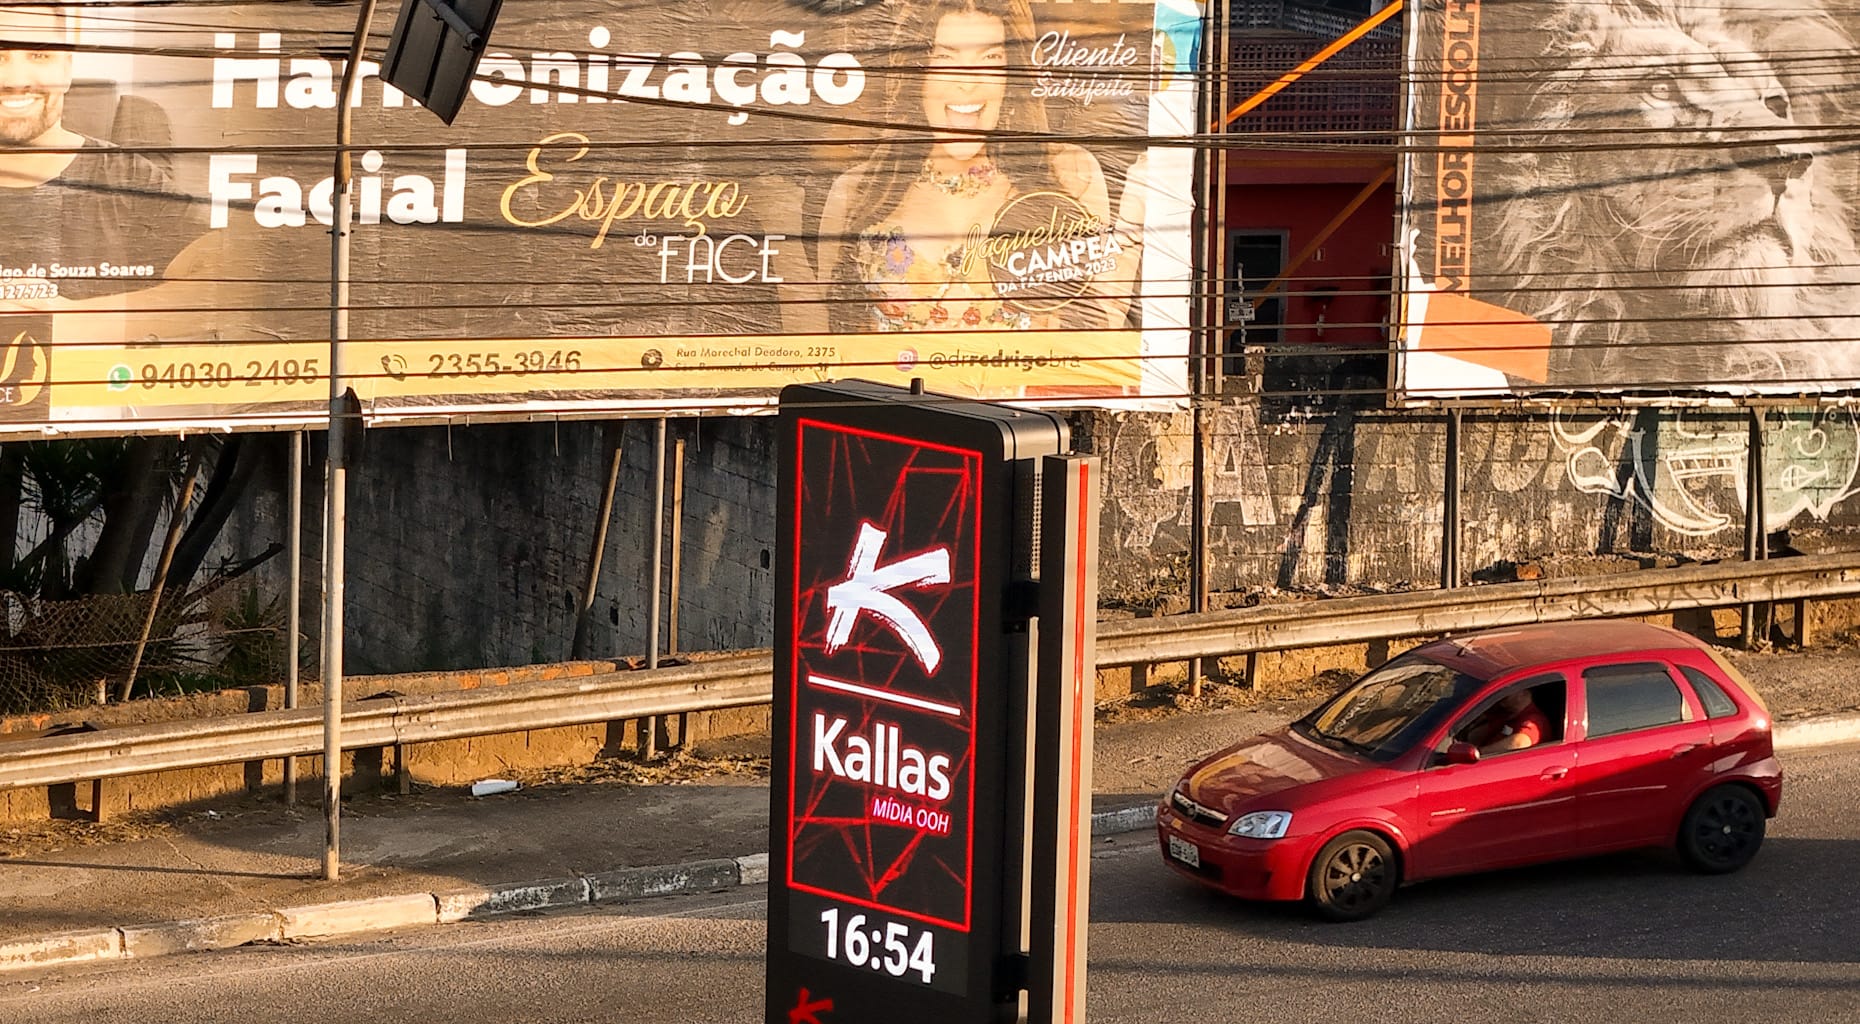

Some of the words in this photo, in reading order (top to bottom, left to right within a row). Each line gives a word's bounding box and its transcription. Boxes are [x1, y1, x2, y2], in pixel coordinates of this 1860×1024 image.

[1031, 30, 1138, 67] Cliente
[212, 26, 866, 126] Haronização
[1031, 71, 1135, 105] Satisfeita
[209, 149, 467, 229] Facial
[500, 133, 748, 249] Espaço
[961, 206, 1102, 275] Jaqueline
[1440, 150, 1469, 297] MELHOR
[50, 263, 96, 278] Souza
[99, 262, 154, 277] Soares
[657, 234, 786, 284] FACE
[997, 281, 1018, 294] DA
[1019, 266, 1083, 290] FAZENDA
[1084, 258, 1117, 276] 2023
[1006, 227, 1123, 276] CAMPEÃ
[141, 358, 319, 390] 94030-2495
[427, 350, 582, 379] 2355-3946
[676, 348, 697, 357] Rua
[807, 347, 836, 357] 2375
[825, 521, 950, 674] K
[813, 713, 951, 801] Kallas
[872, 796, 913, 825] MÍDIA
[916, 808, 949, 833] OOH
[821, 908, 936, 984] 16:54
